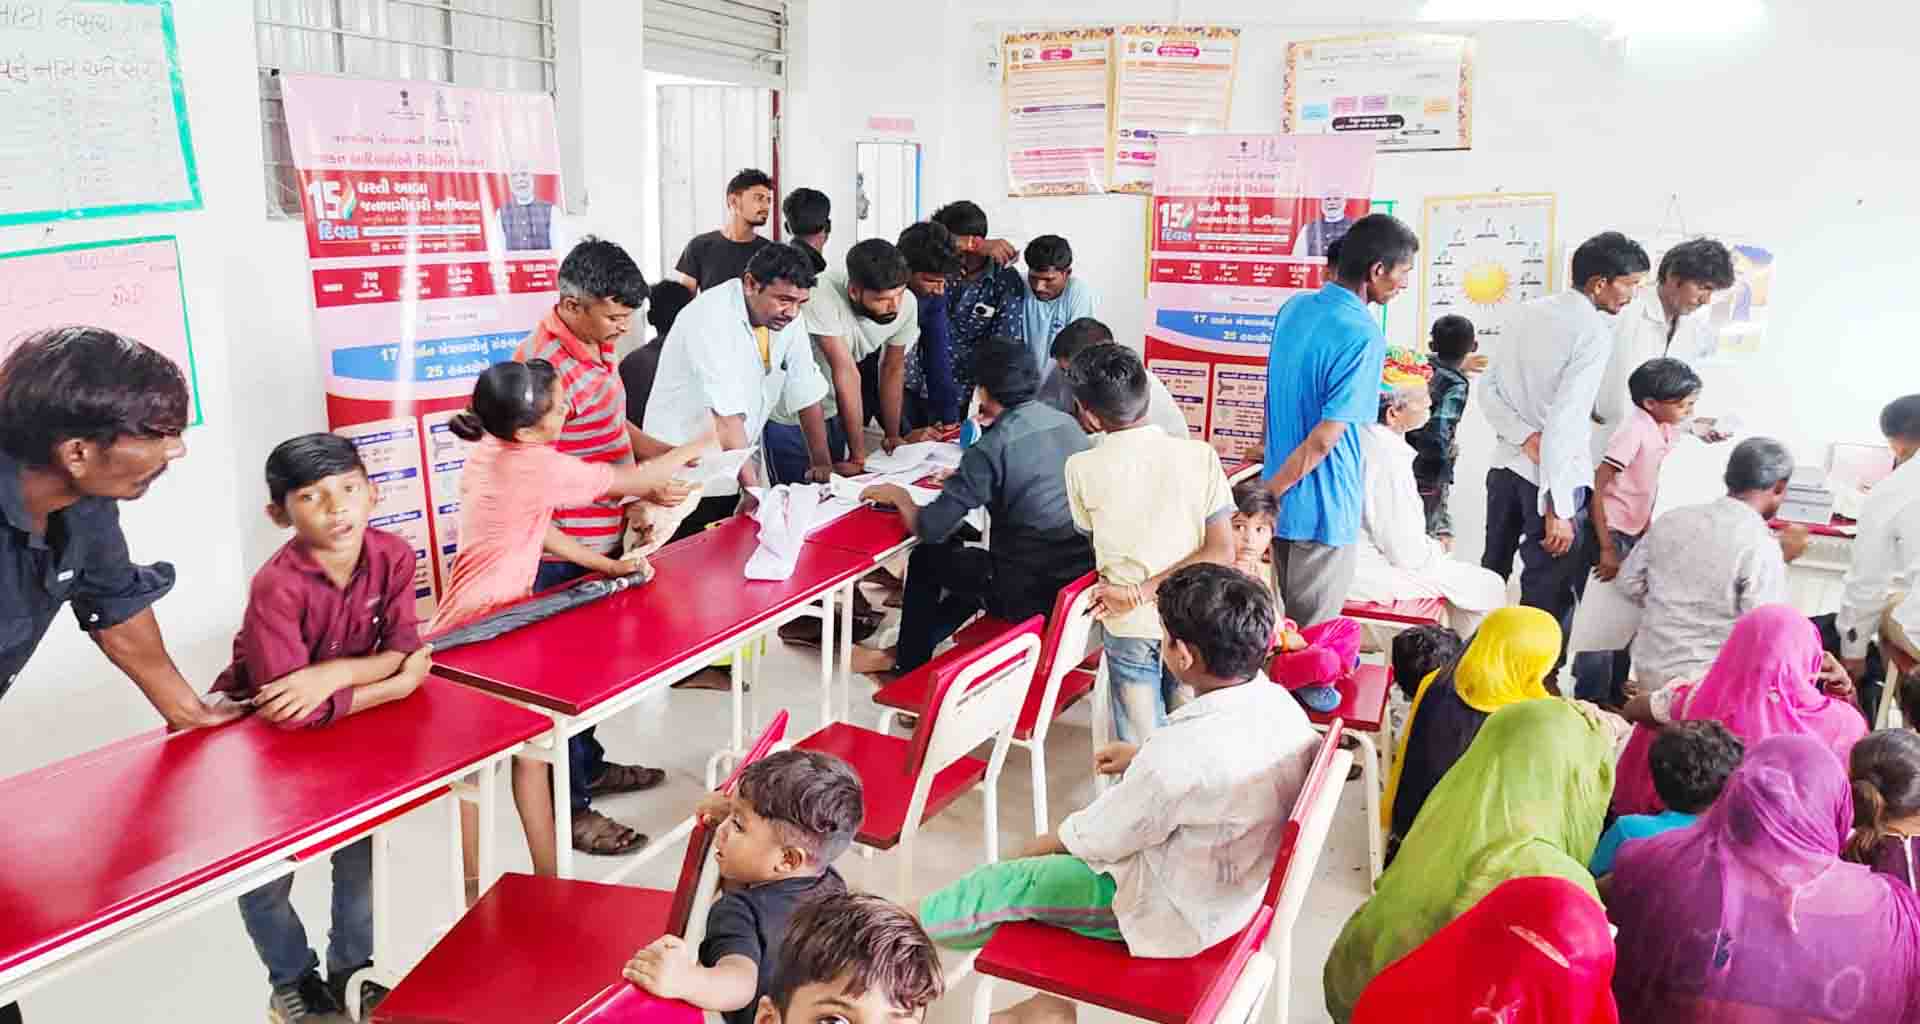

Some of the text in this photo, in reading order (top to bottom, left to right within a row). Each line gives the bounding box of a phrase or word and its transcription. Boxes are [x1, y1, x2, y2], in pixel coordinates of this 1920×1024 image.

[357, 177, 428, 194] ધરતી આબા
[308, 180, 341, 220] 15
[1159, 203, 1184, 229] 15
[319, 220, 359, 240] દિવસ
[1161, 228, 1192, 241] દિવસ
[1193, 314, 1207, 324] 17
[383, 347, 400, 361] 17
[425, 365, 443, 378] 25
